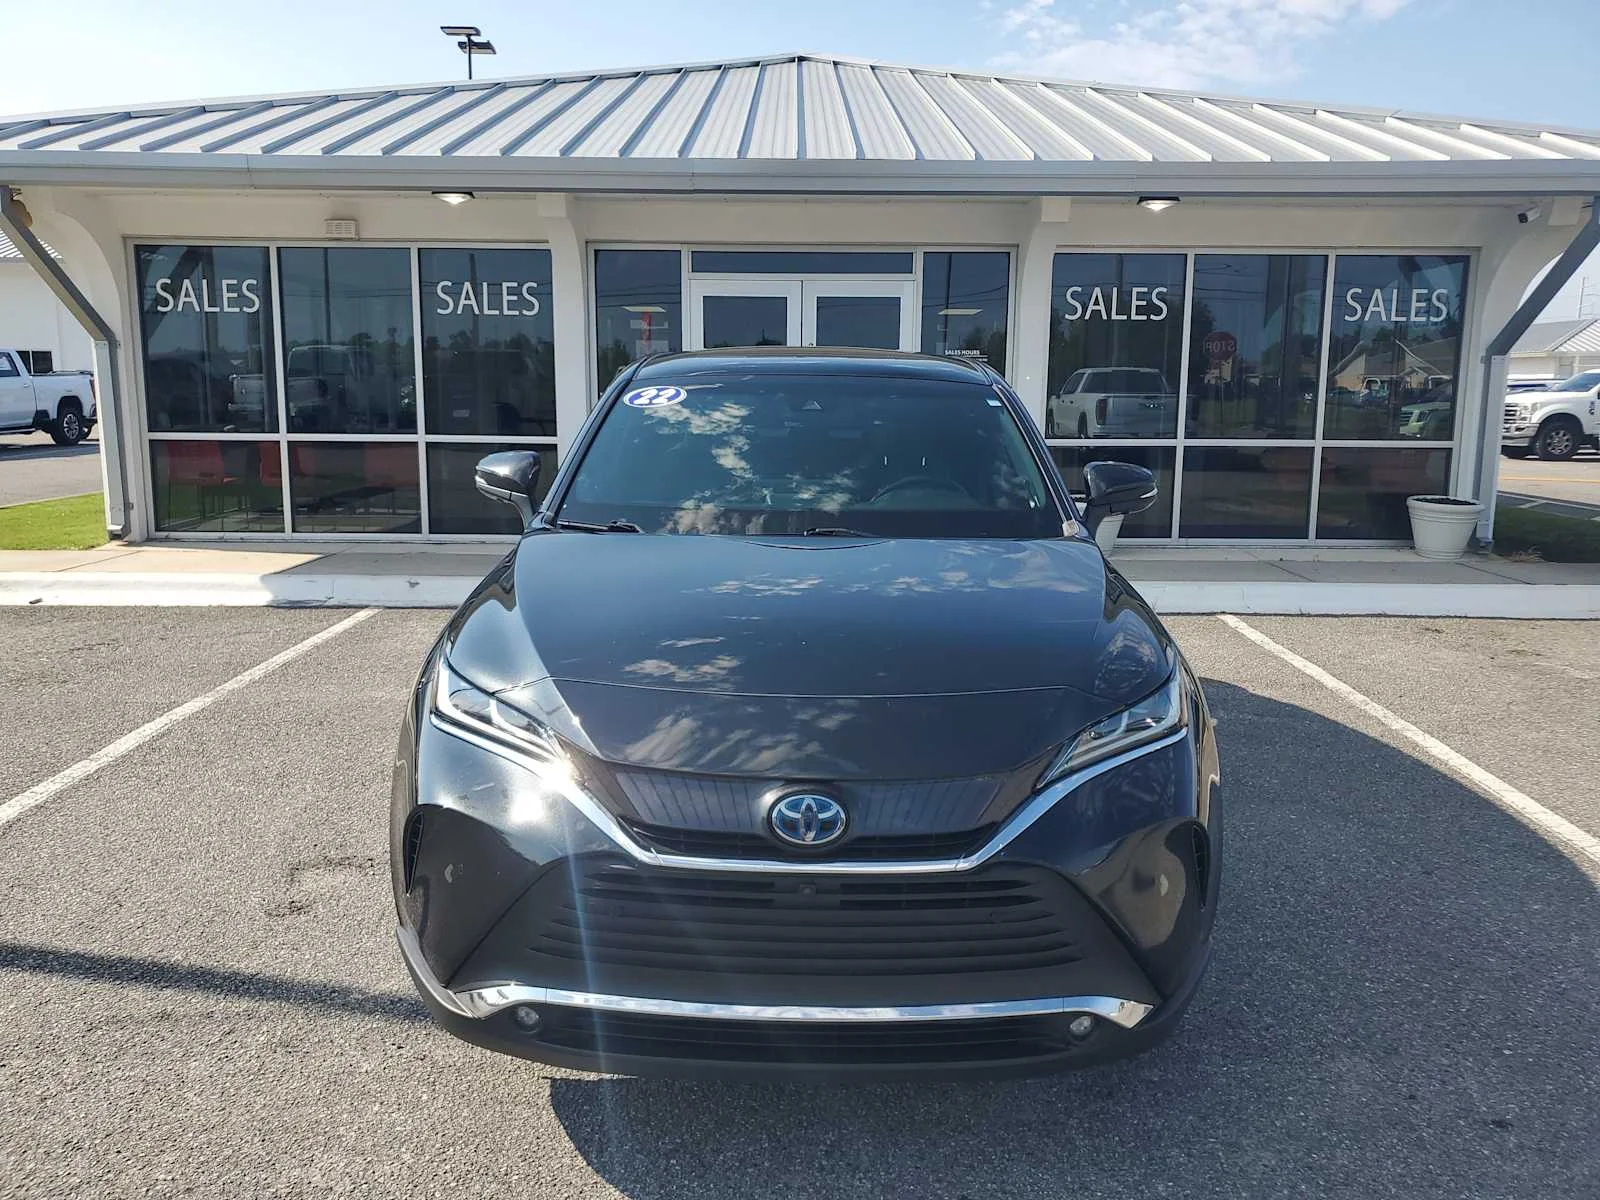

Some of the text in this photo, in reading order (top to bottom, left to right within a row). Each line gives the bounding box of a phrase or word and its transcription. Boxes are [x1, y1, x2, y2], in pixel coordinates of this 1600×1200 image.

[155, 278, 260, 313] SALES
[436, 280, 540, 316] SALES
[1064, 286, 1168, 321] SALES
[1344, 287, 1448, 322] SALES
[633, 388, 677, 405] 22
